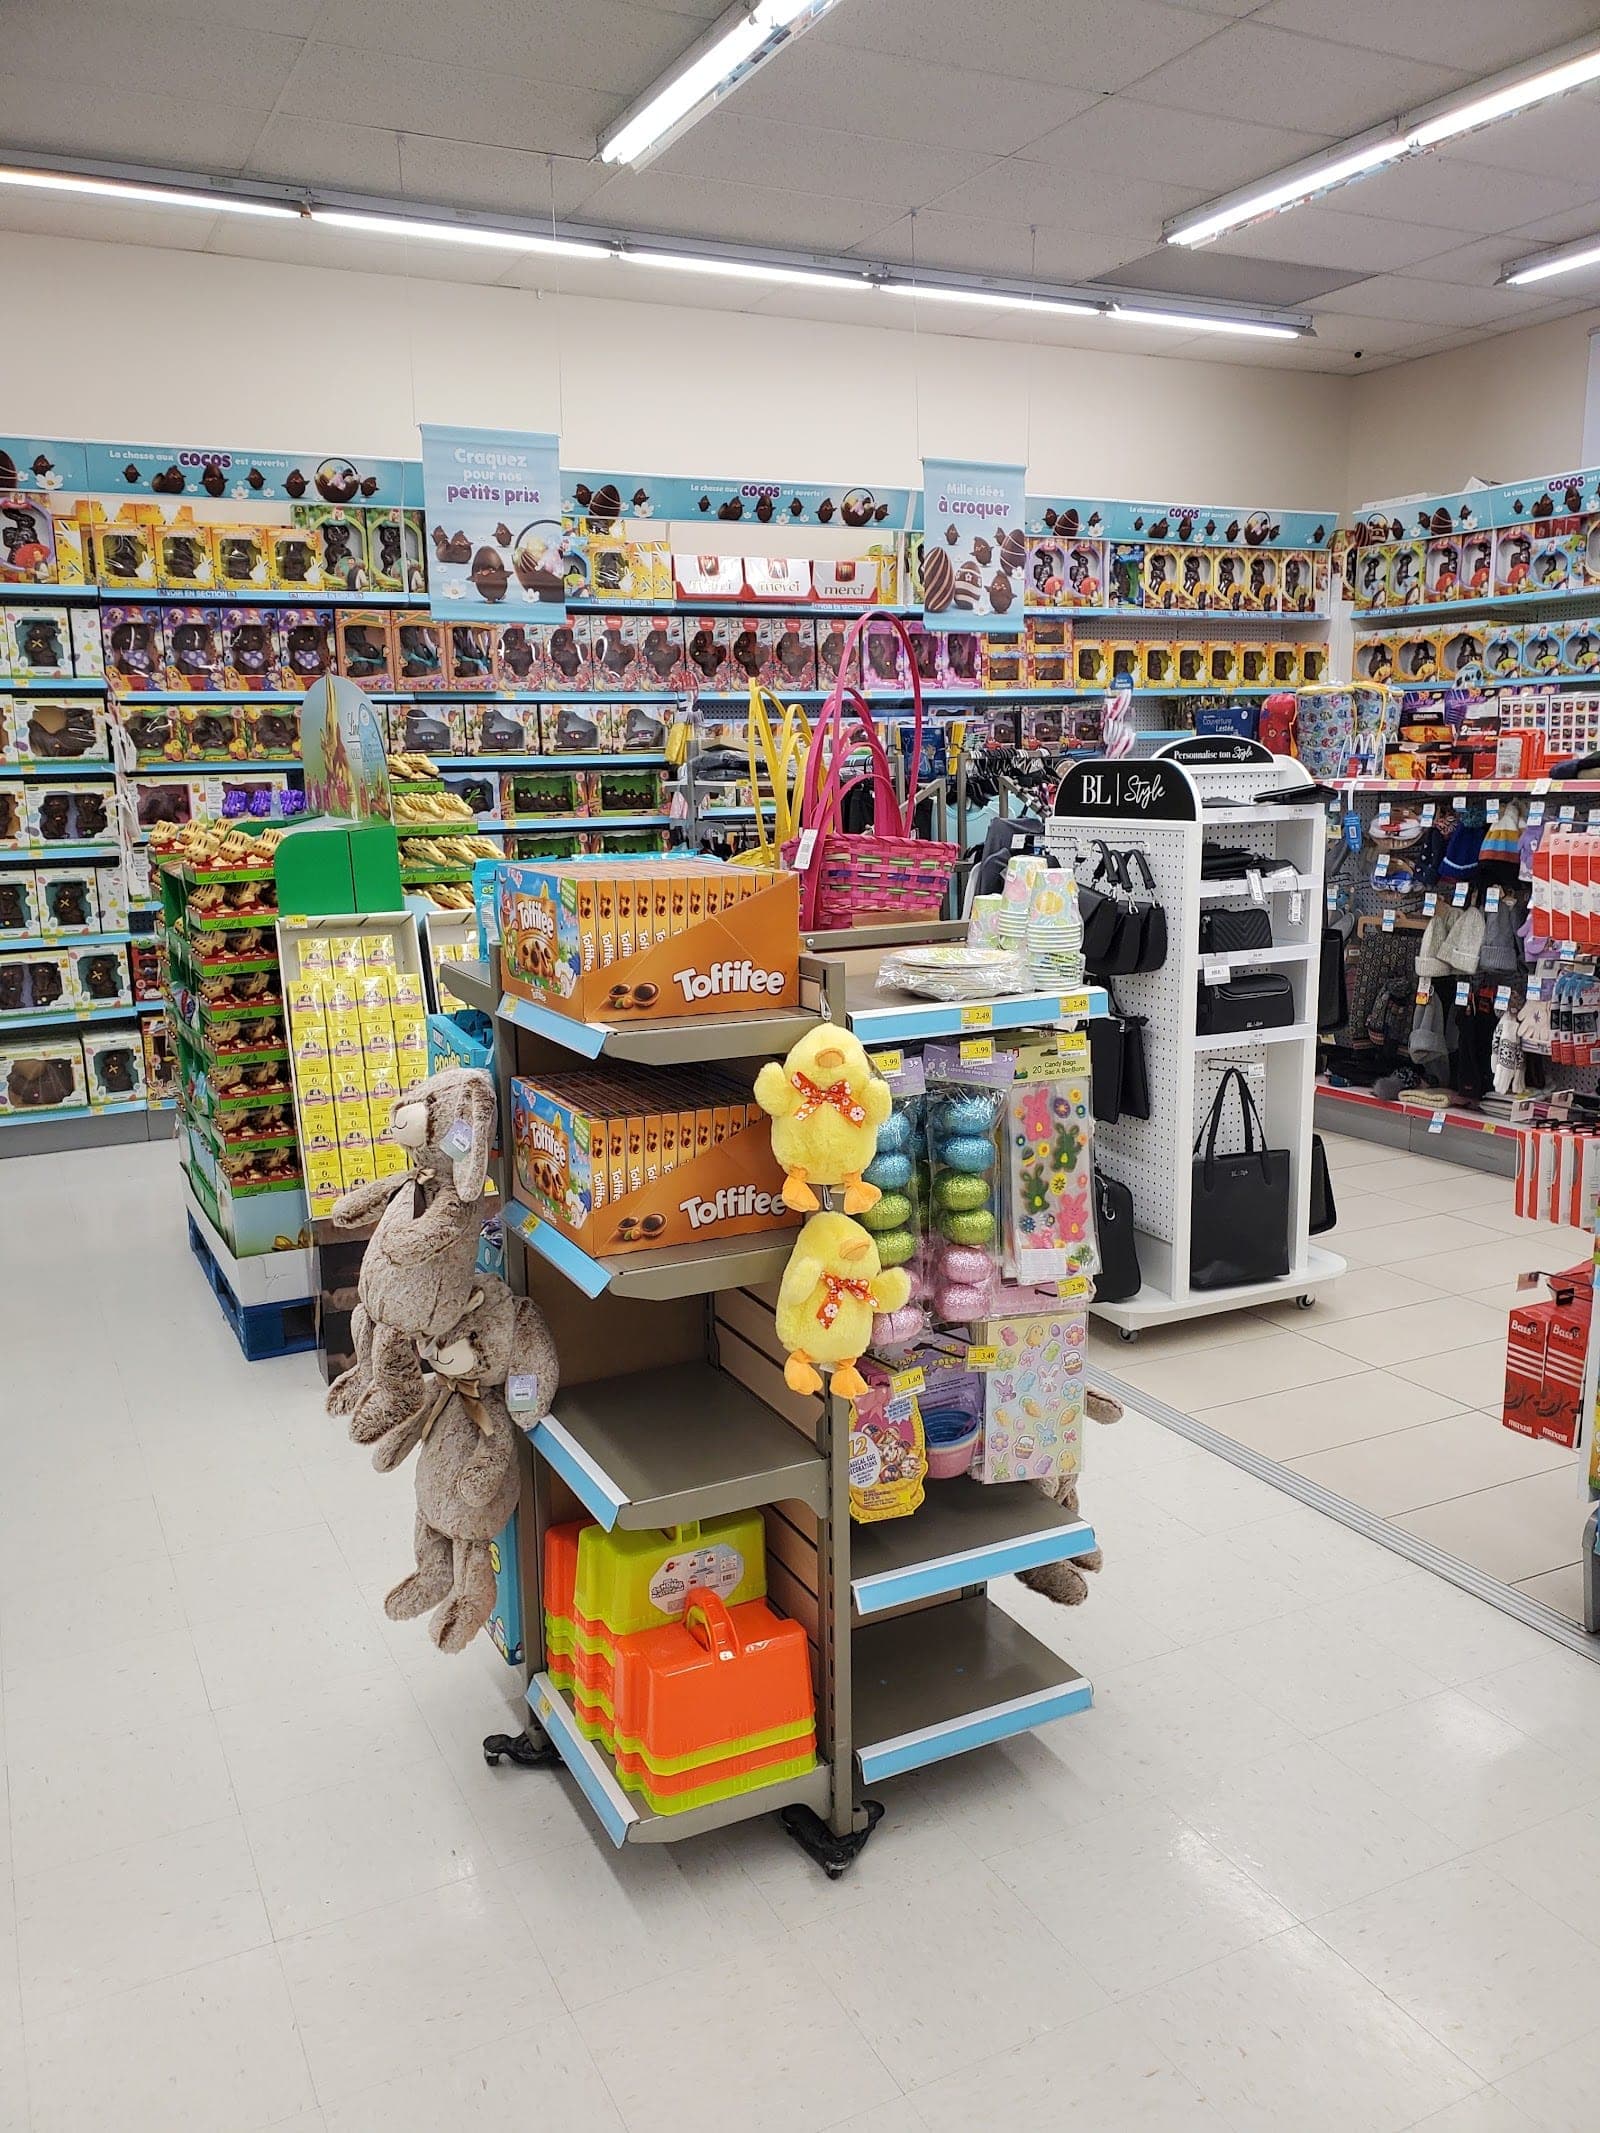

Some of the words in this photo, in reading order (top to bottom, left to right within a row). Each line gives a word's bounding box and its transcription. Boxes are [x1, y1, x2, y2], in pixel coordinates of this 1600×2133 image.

[109, 450, 121, 458] La
[123, 451, 154, 460] chasse
[179, 453, 231, 468] COCOS
[235, 458, 249, 466] est
[454, 448, 527, 469] Craquez
[463, 469, 495, 481] pour
[499, 471, 521, 481] nos
[741, 485, 780, 498] COCOS
[946, 483, 973, 495] Mille
[975, 484, 1004, 497] idées
[1548, 476, 1584, 492] COCOS
[447, 482, 500, 503] petits
[504, 486, 540, 506] prix
[938, 495, 948, 513] à
[952, 501, 1010, 520] croquer
[1169, 508, 1199, 519] COCOS
[823, 583, 865, 595] merci
[1173, 750, 1218, 760] Personnalise
[1232, 745, 1254, 761] Style
[1080, 774, 1111, 804] BL
[1123, 773, 1166, 809] Style
[517, 901, 554, 939] Toffifee
[582, 931, 595, 973] Toffifee
[673, 960, 786, 1003] Toffifee
[975, 1012, 990, 1020] 2.49
[974, 1046, 989, 1054] 3.99
[883, 1059, 898, 1067] 3.99
[1032, 1065, 1042, 1074] 20
[530, 1120, 566, 1167] Toffifee
[593, 1171, 606, 1209] Toffifee
[679, 1184, 786, 1229] Toffifee
[1511, 1319, 1531, 1335] Bass
[1552, 1324, 1574, 1340] Bass
[907, 1375, 921, 1385] 1.69
[1508, 1419, 1533, 1434] maxell
[1542, 1426, 1568, 1443] maxell
[848, 1436, 868, 1459] 12
[849, 1460, 878, 1475] ECORATIONS
